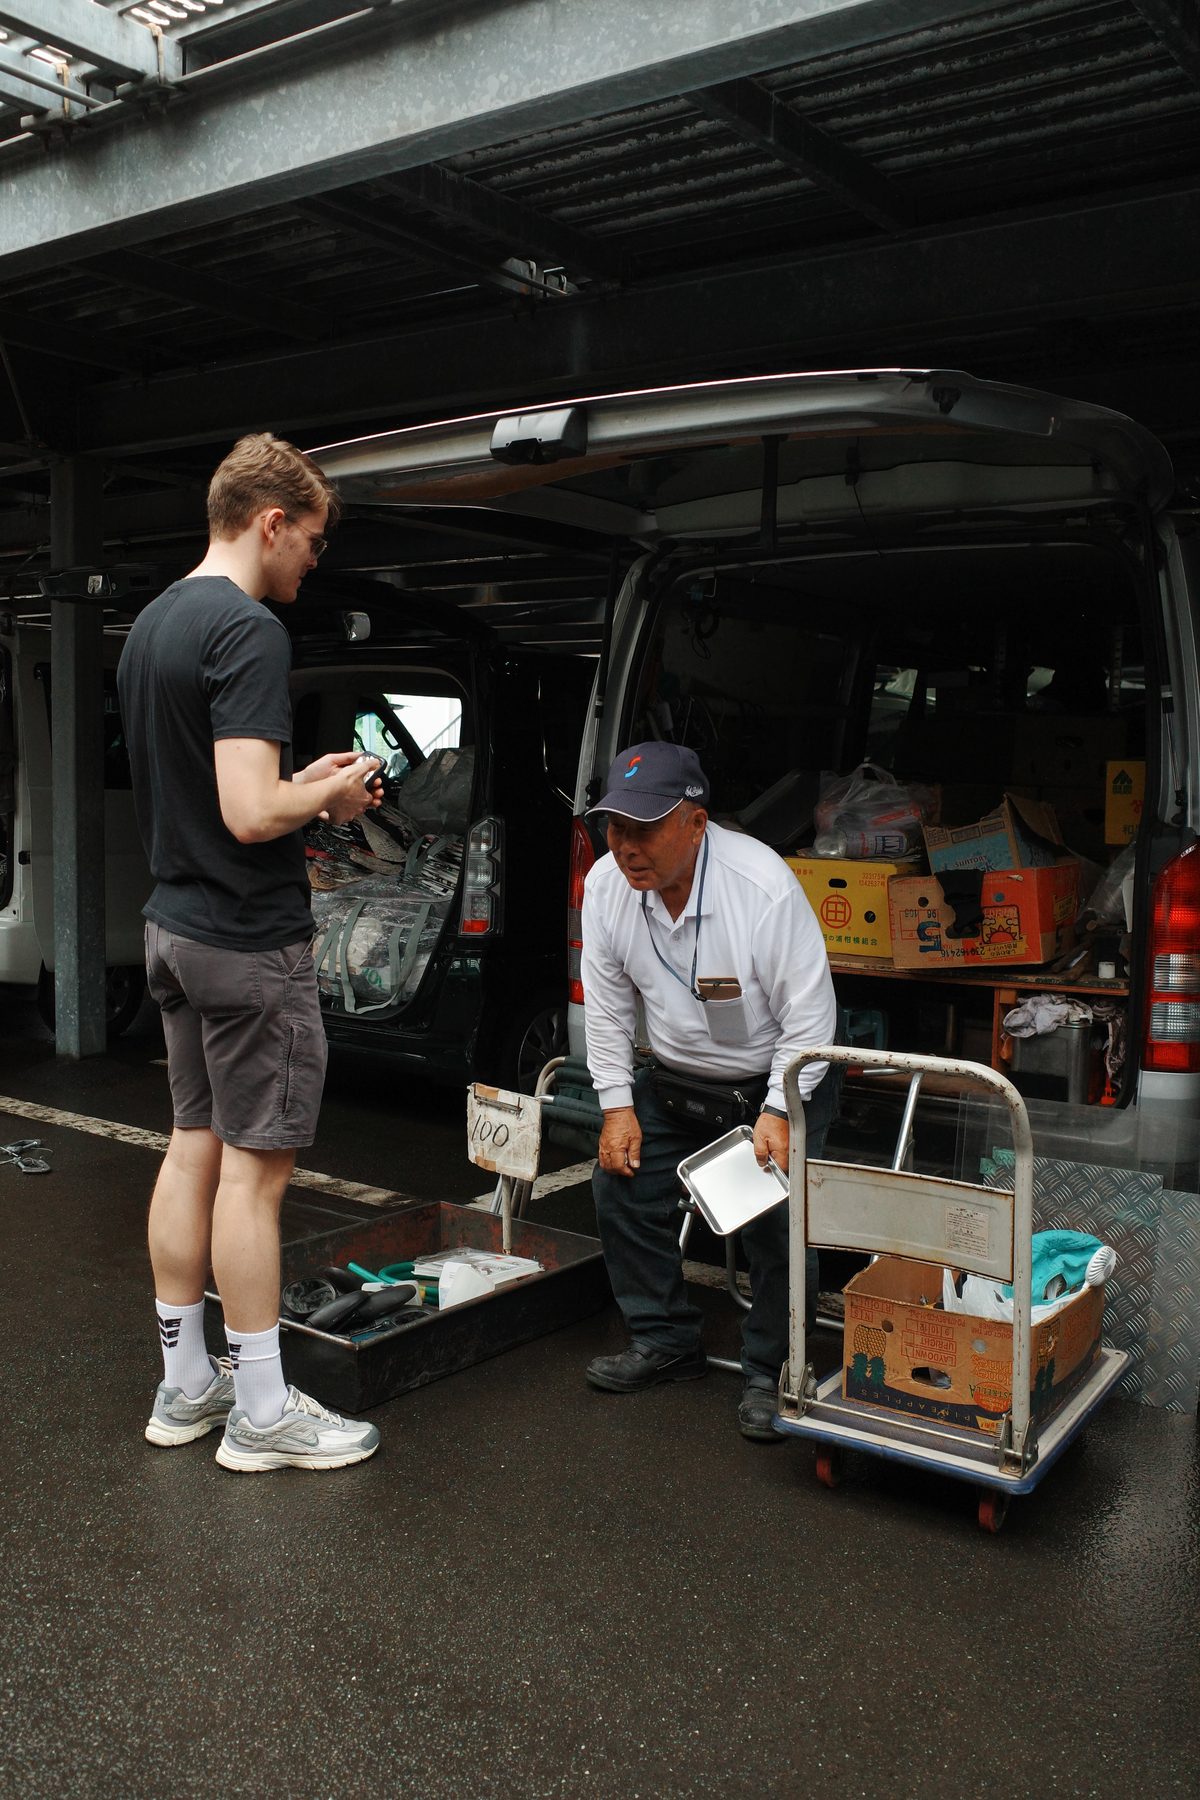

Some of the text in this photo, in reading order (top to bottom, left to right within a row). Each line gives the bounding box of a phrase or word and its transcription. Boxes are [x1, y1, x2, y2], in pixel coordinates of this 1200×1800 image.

[917, 920, 942, 953] 5
[471, 1114, 509, 1147] 100
[915, 1349, 955, 1366] LAYDOWN
[921, 1336, 955, 1351] UPRIGHT
[860, 1388, 971, 1422] PINEAPPLES
